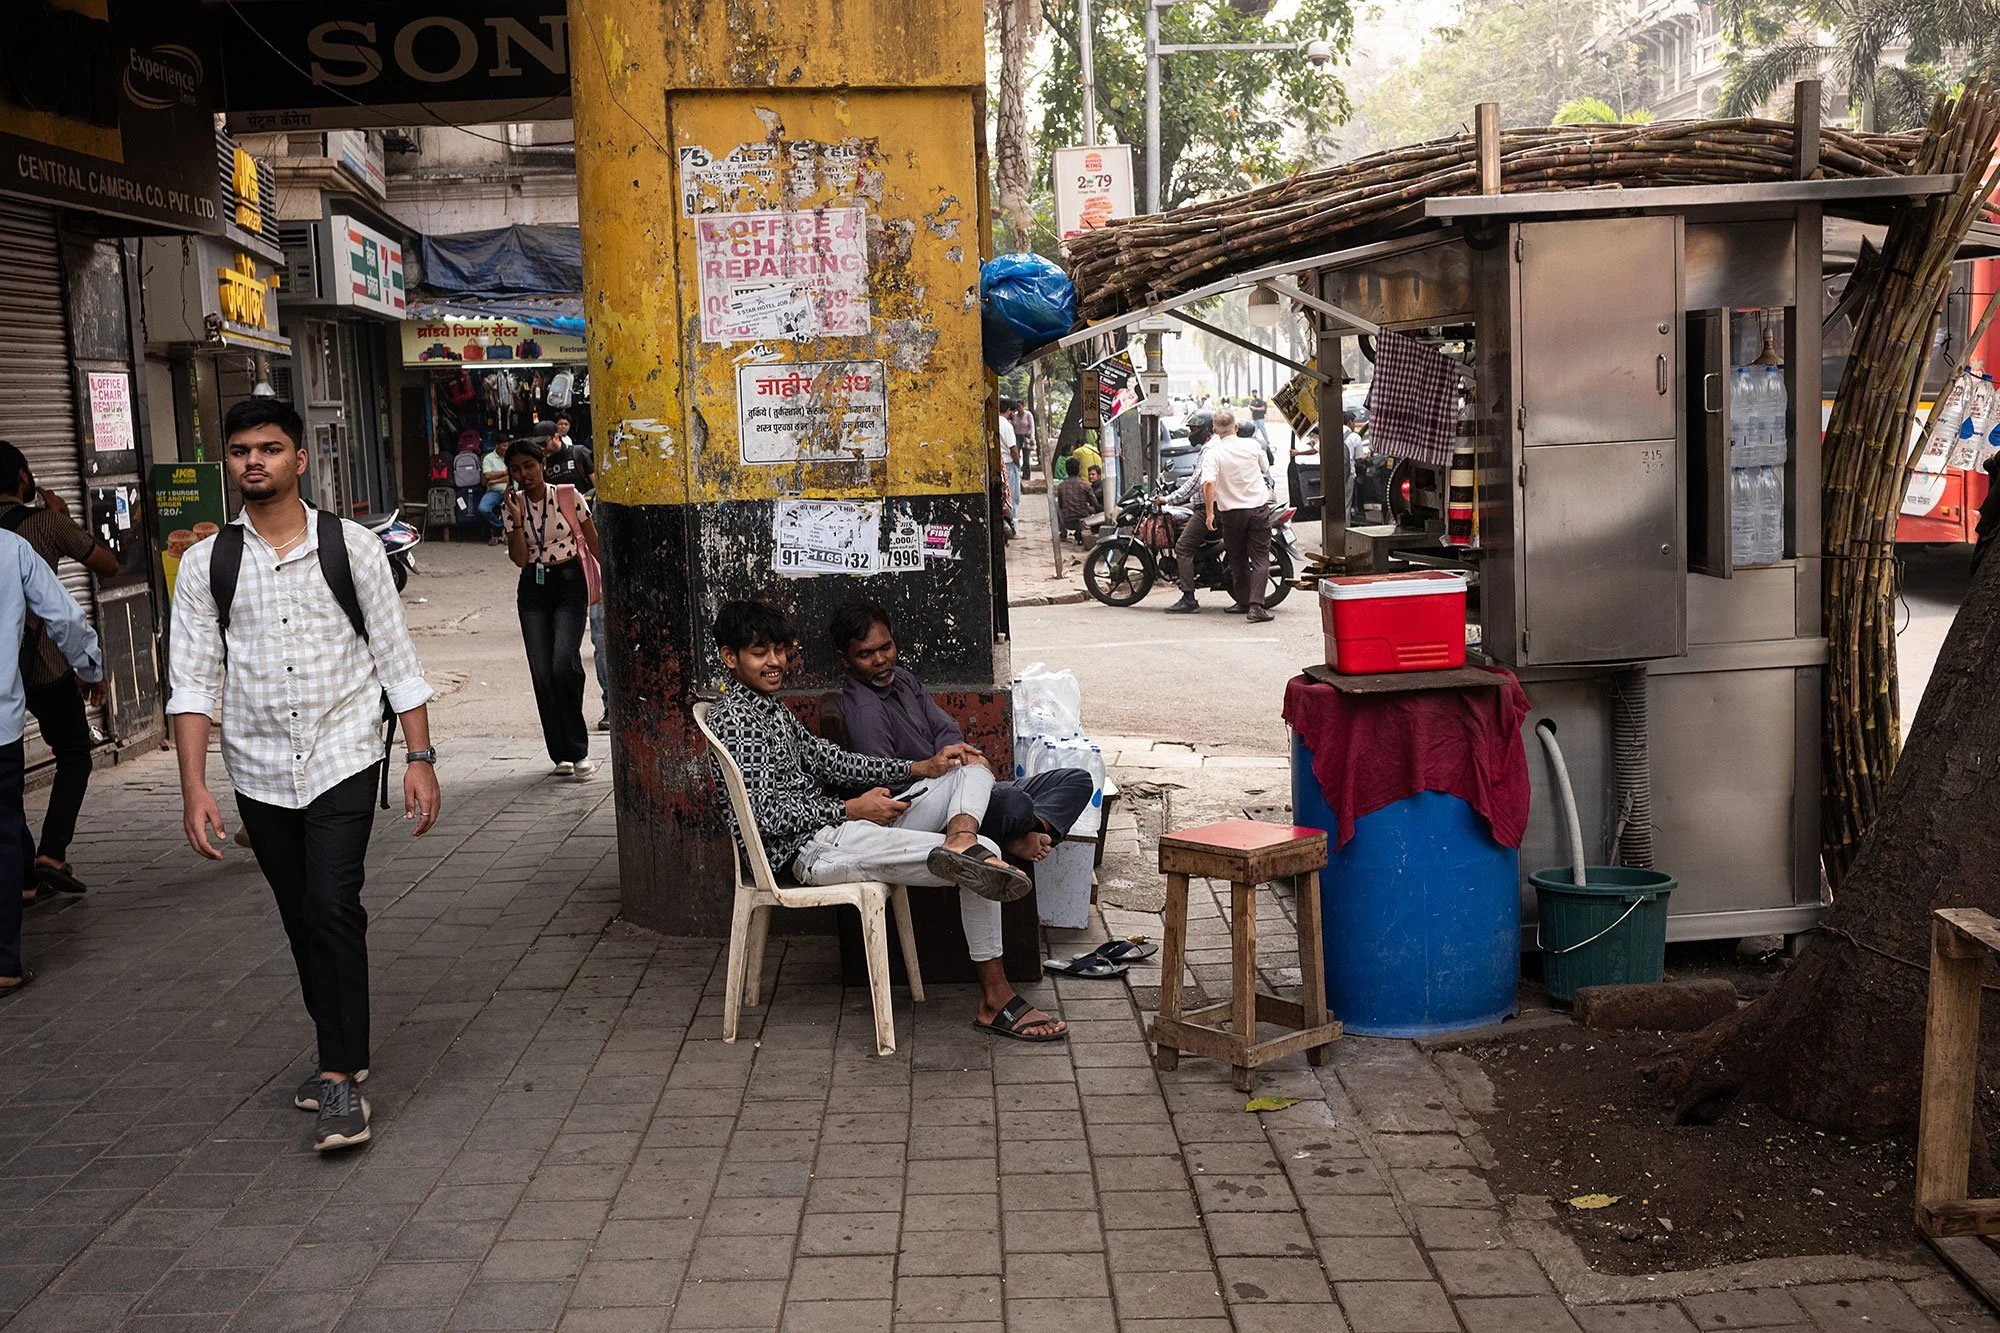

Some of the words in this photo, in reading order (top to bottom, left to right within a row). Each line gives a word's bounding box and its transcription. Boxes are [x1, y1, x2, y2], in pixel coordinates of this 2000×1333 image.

[130, 48, 196, 92] Experience
[18, 153, 87, 191] CENTRAL
[88, 171, 146, 204] CAMERA
[145, 185, 167, 209] CO.
[168, 190, 193, 215] PVT.
[194, 197, 218, 220] LTD.
[730, 217, 832, 239] OFFICE
[730, 236, 833, 257] CHAIR
[705, 253, 860, 280] REPAIRING
[741, 306, 757, 315] STAR
[757, 302, 776, 312] HOTEL
[777, 299, 789, 307] JOB
[491, 322, 519, 338] सेंटर
[97, 378, 121, 390] OFFICE
[755, 372, 813, 399] जाहीर
[98, 390, 122, 401] CHAIR
